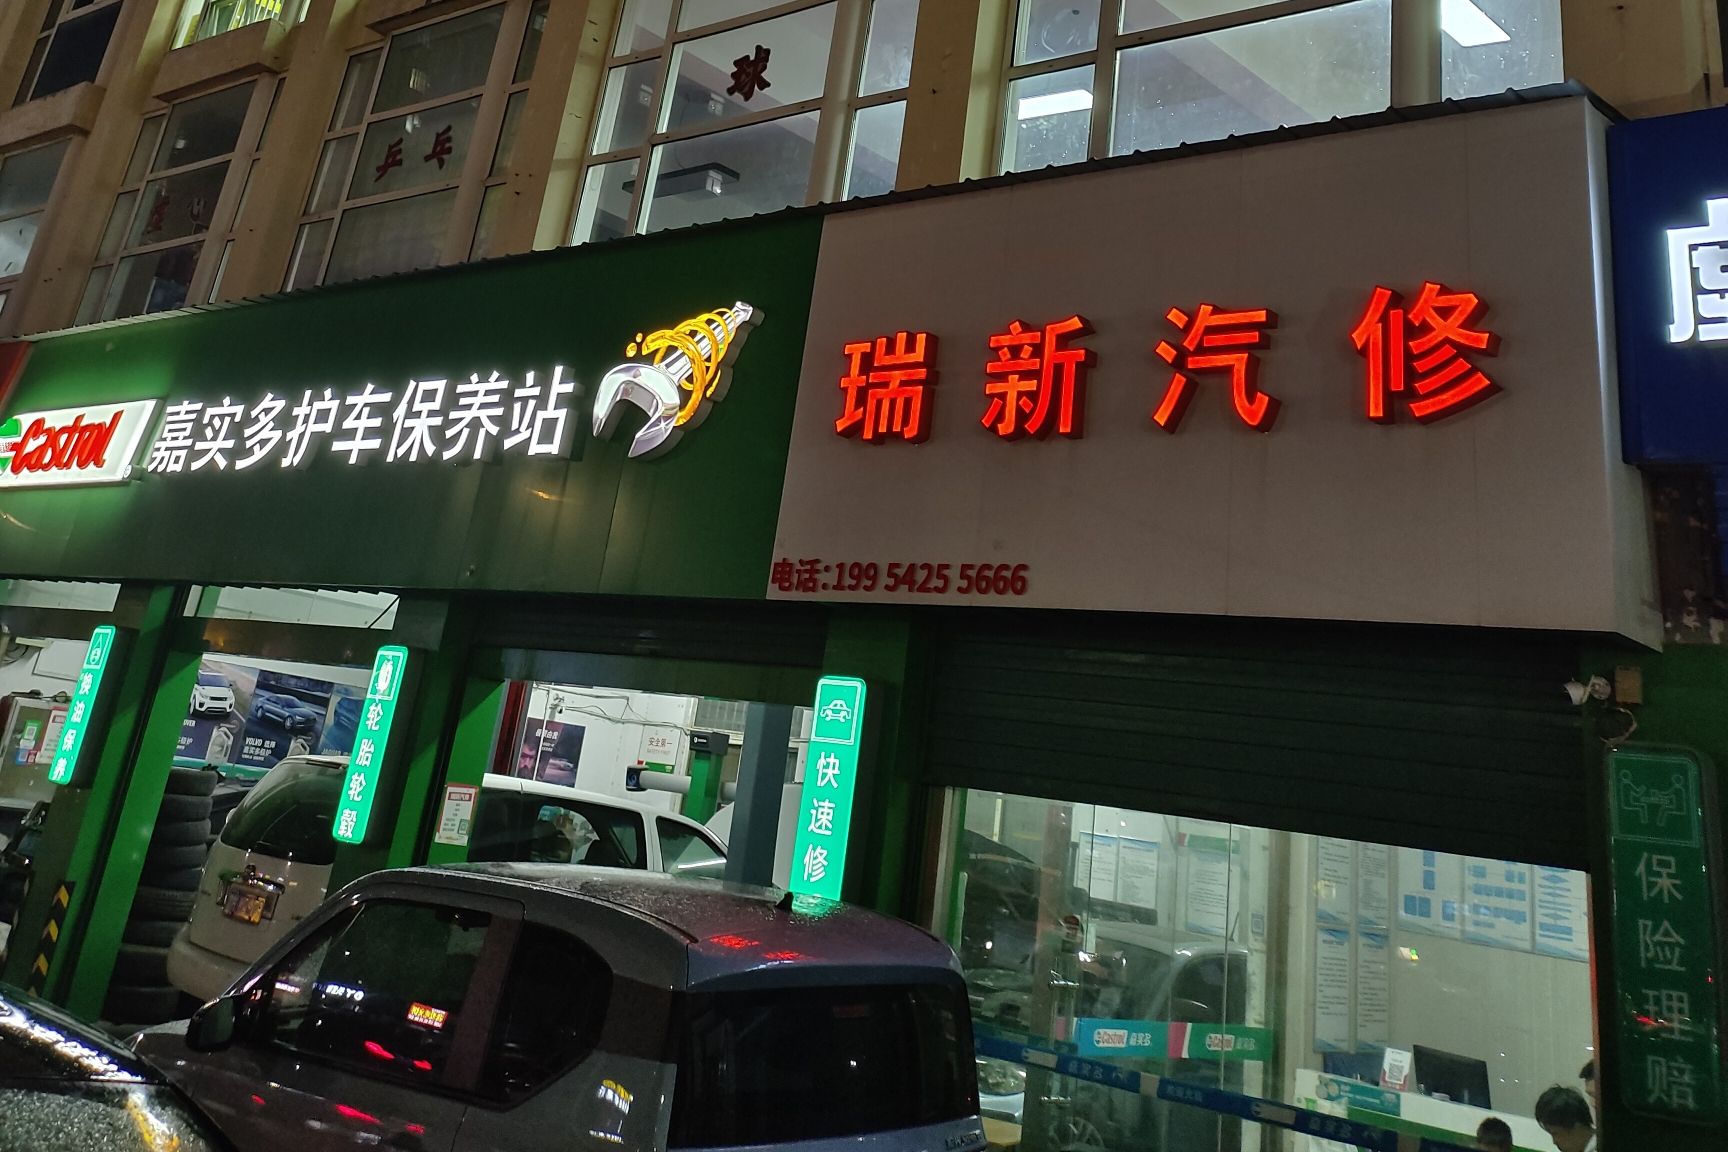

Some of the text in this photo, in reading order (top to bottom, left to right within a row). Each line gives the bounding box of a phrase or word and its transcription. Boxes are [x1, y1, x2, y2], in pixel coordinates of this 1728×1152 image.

[726, 45, 771, 102] 球
[834, 281, 1500, 444] 瑞新汽修
[9, 410, 124, 475] Castrol
[147, 365, 574, 474] 嘉实多护车保养站
[884, 562, 950, 594] 5425
[956, 563, 1030, 595] 5666
[245, 737, 263, 747] VOLVO
[338, 703, 384, 838] 轮胎轮毂
[648, 737, 673, 747] 安全第一
[803, 751, 841, 882] 快速修
[1635, 851, 1698, 1112] 保险理赔
[1101, 1030, 1125, 1045] Castrol
